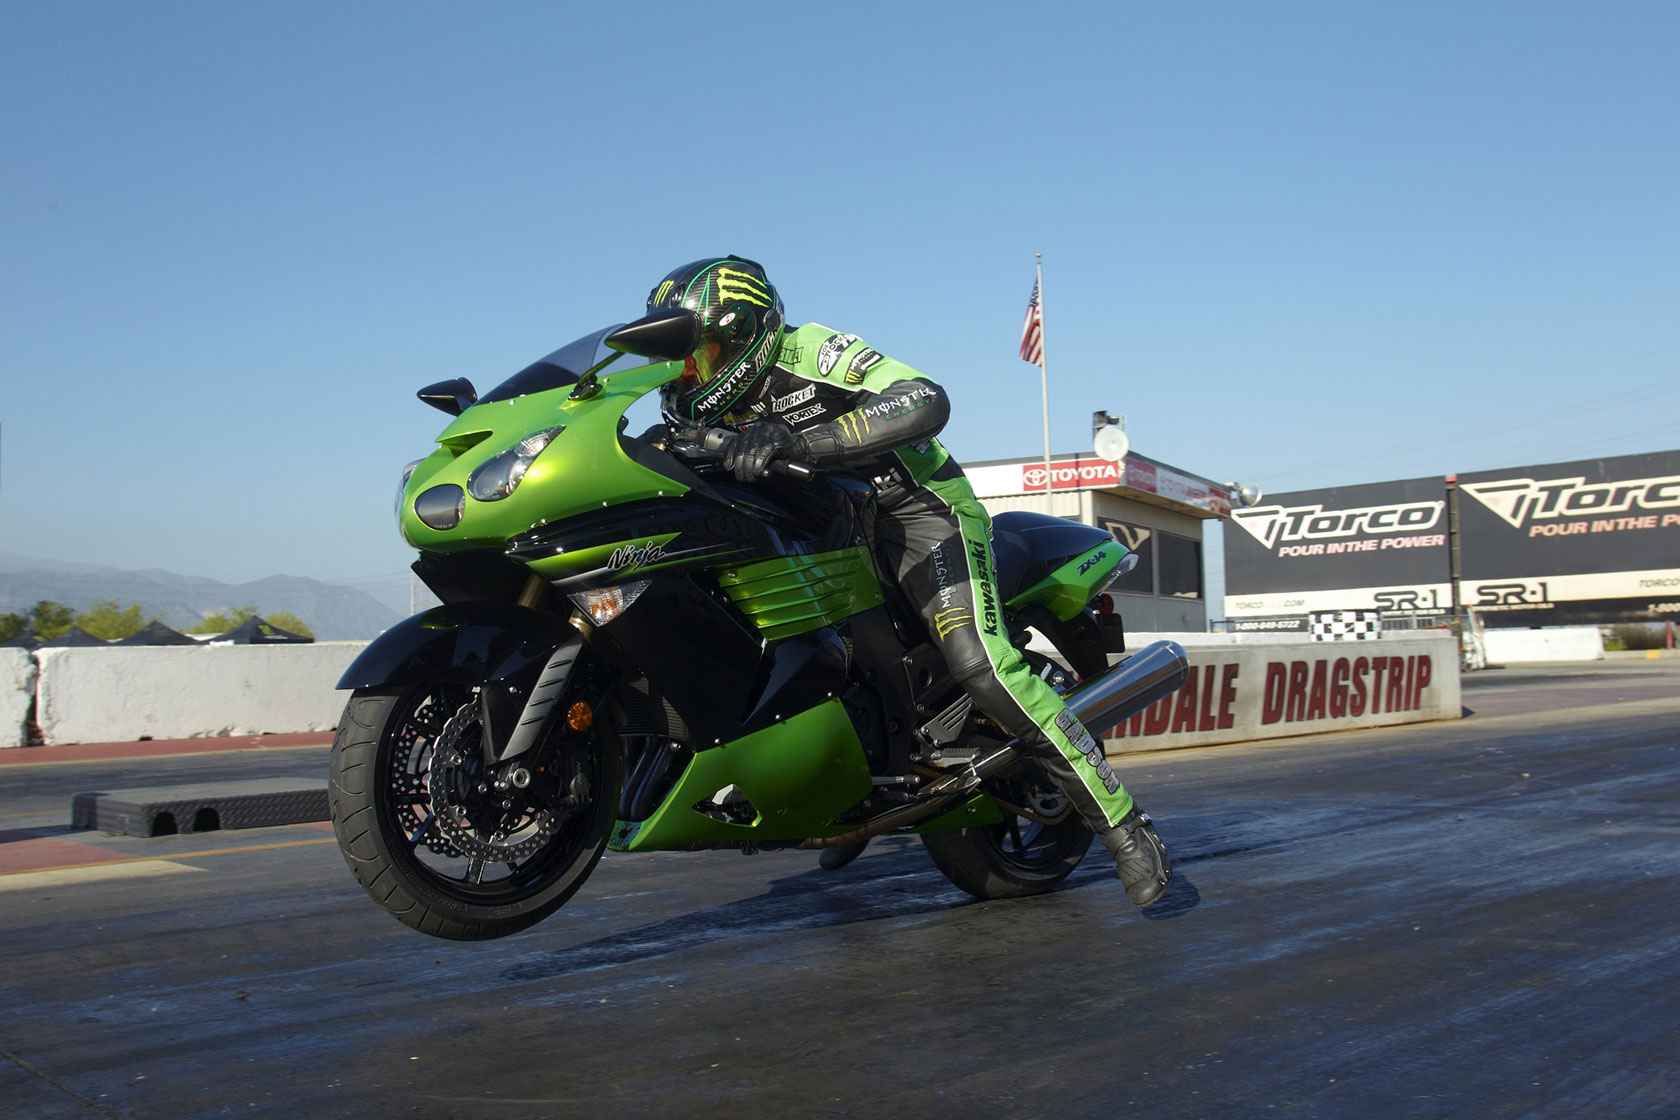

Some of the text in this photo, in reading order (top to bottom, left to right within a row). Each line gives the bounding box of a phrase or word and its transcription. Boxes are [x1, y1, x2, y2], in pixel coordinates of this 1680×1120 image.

[697, 361, 751, 412] MONSTER
[773, 382, 816, 413] ROCKET
[782, 403, 827, 426] VORTEX
[1050, 465, 1118, 482] TOYOTA
[1529, 521, 1588, 537] POUR
[607, 541, 666, 572] Ninja
[1279, 544, 1324, 557] POUR
[1381, 534, 1445, 550] POWER
[1261, 654, 1432, 725] DRAGSTRIP
[1054, 707, 1121, 795] GADSON
